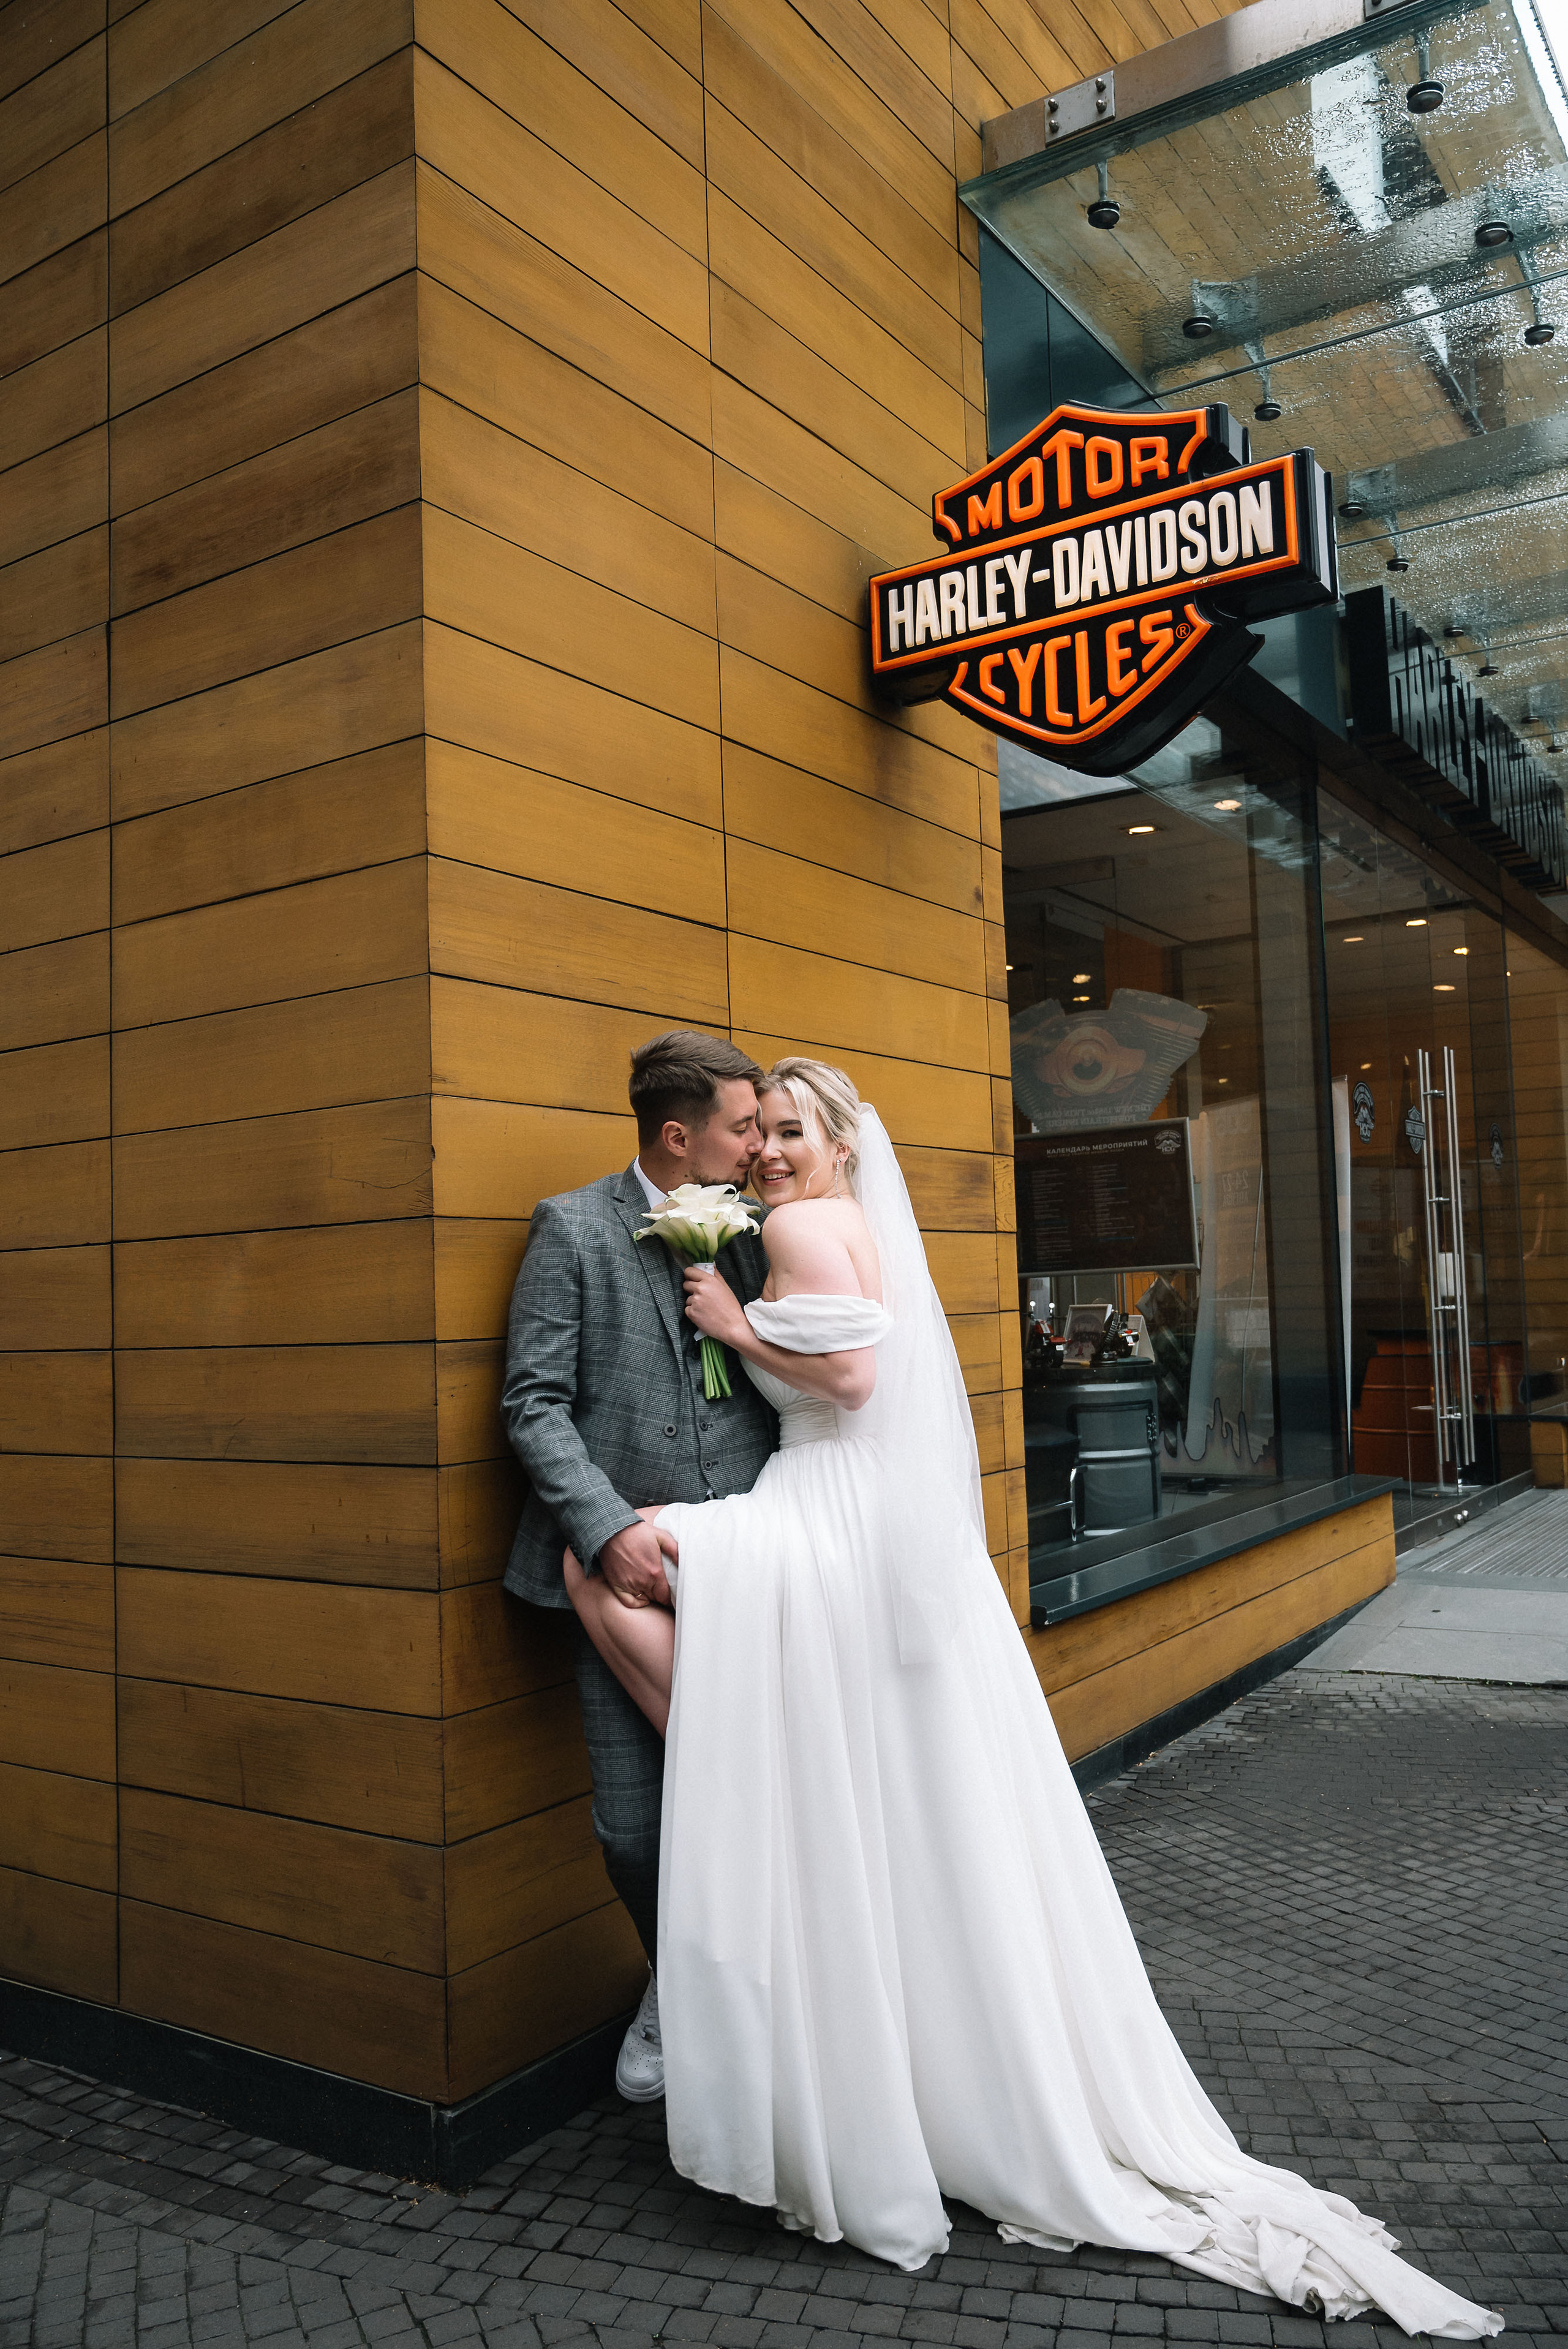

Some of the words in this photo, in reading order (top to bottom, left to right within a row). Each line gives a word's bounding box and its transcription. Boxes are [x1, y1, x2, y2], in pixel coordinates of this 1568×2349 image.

[967, 429, 1169, 537] MOTOR
[888, 480, 1274, 652] HARLEY-DAVIDSON
[979, 609, 1173, 728] CYCLES
[1046, 1145, 1090, 1155] КАЛЕНДАРЬ
[1092, 1139, 1148, 1151] МЕРОПРИЯТИЙ
